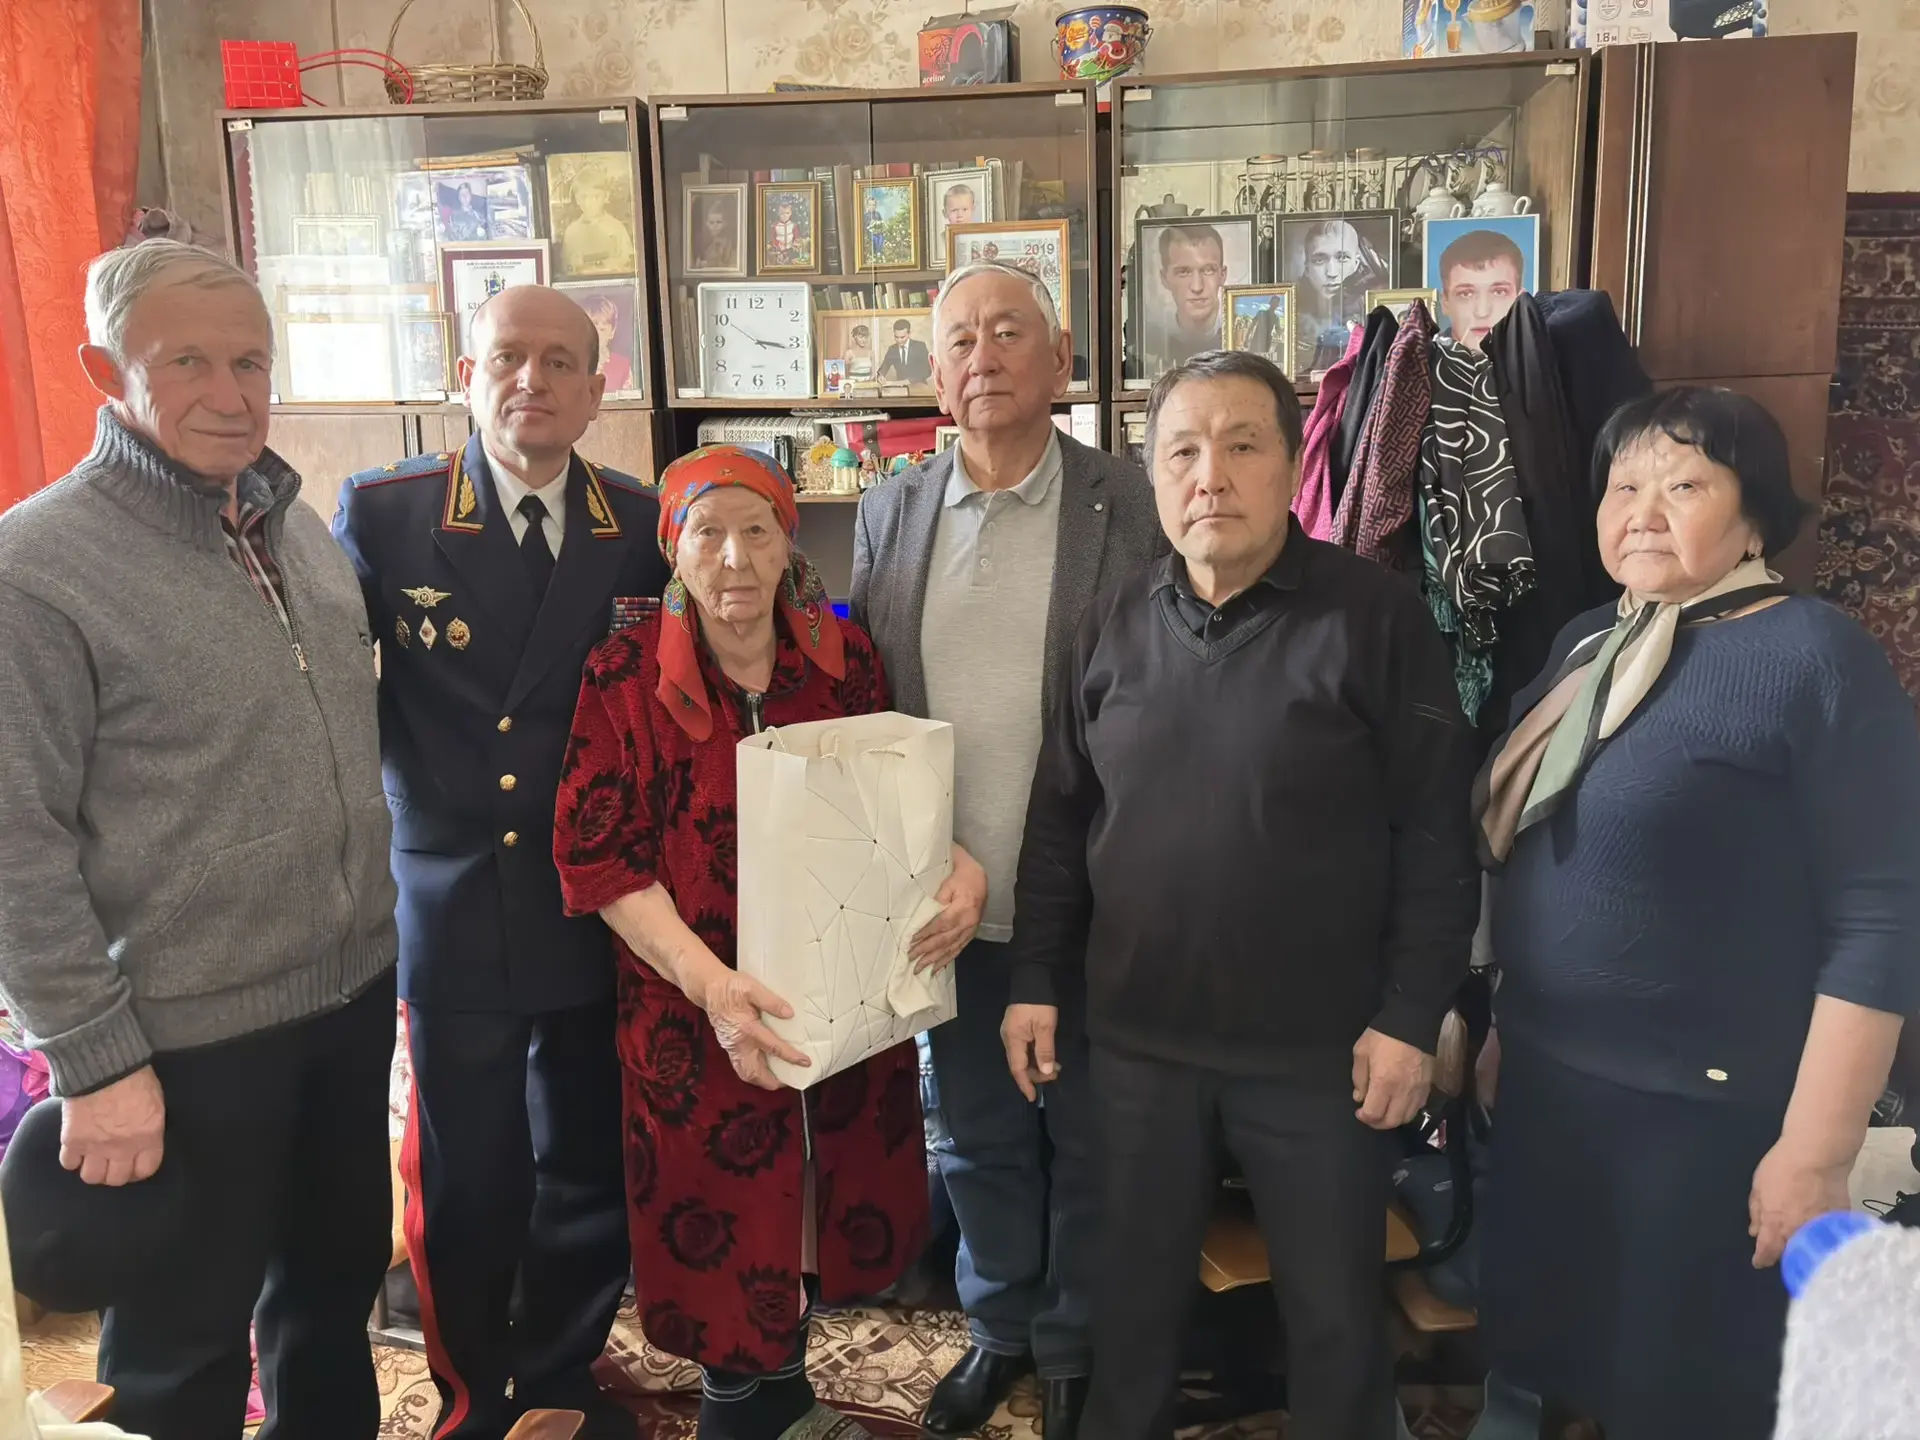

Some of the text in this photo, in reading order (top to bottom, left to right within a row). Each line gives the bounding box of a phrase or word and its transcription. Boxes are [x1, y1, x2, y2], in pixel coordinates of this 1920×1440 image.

[1596, 32, 1610, 43] 1.8
[922, 73, 946, 84] aceline
[1025, 243, 1055, 255] 2019
[726, 297, 737, 309] 11
[748, 297, 765, 310] 12
[777, 297, 783, 309] 1
[714, 313, 729, 326] 10
[789, 310, 800, 322] 2
[714, 335, 726, 348] 9
[789, 336, 800, 349] 3
[715, 359, 727, 373] 8
[789, 359, 800, 371] 4
[732, 374, 742, 387] 7
[752, 373, 764, 387] 6
[776, 374, 786, 387] 5
